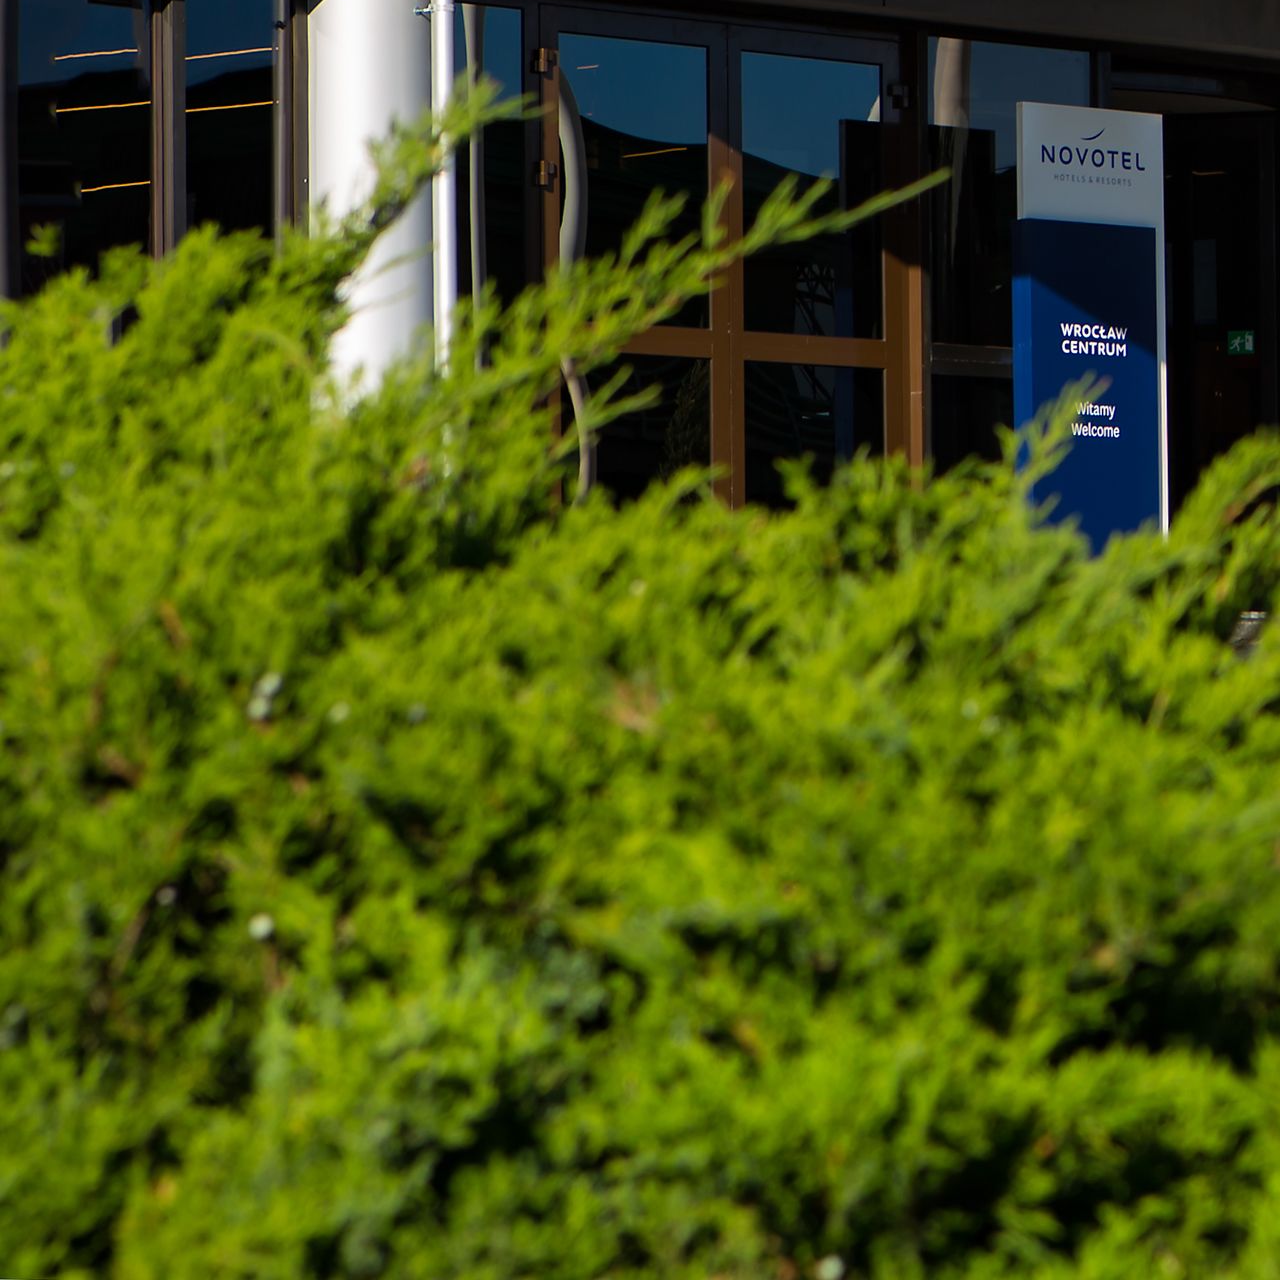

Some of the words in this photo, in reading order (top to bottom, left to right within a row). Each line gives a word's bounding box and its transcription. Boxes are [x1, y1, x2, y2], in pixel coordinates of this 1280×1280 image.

[1041, 144, 1146, 171] NOVOTEL
[1054, 174, 1086, 183] HOTELS
[1095, 176, 1132, 187] RESORTS
[1060, 323, 1128, 340] WROCŁAW
[1061, 340, 1127, 357] CENTRUM
[1075, 401, 1116, 420] Witamy
[1071, 422, 1120, 438] Welcome
